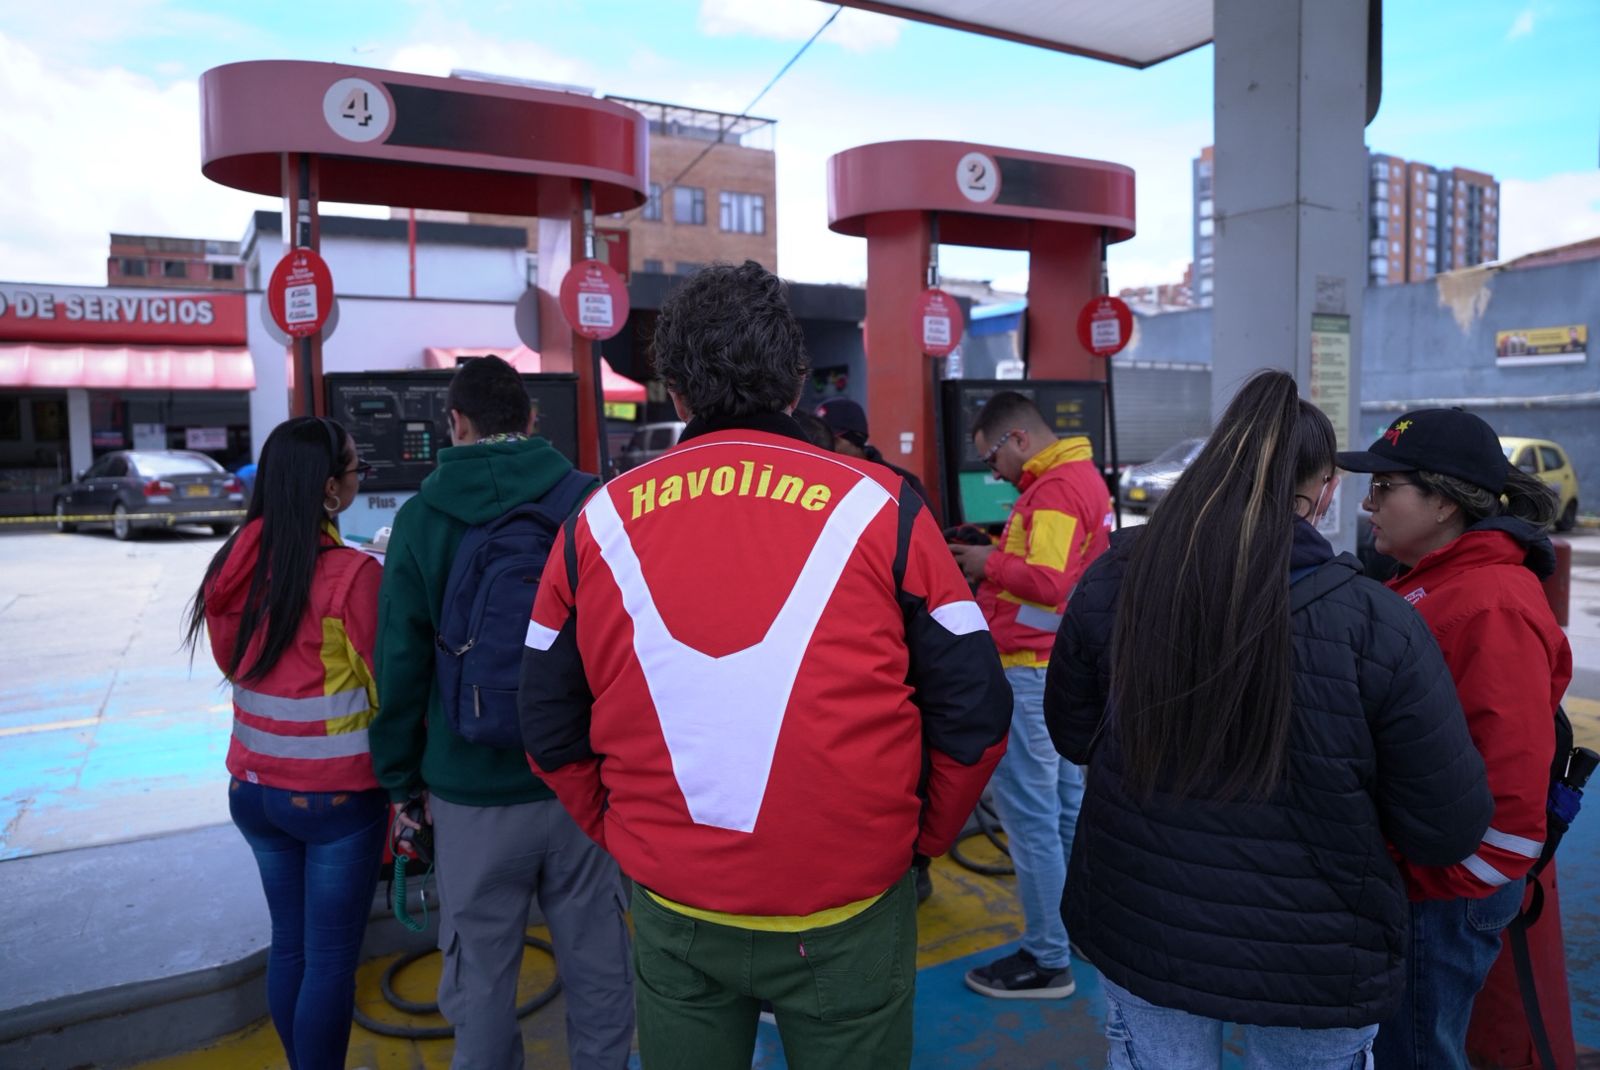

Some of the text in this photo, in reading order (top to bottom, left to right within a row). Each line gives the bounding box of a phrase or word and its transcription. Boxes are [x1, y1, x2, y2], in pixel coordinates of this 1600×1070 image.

[339, 86, 373, 127] 4
[966, 160, 987, 191] 2
[15, 292, 56, 320] DE
[65, 294, 215, 325] SERVICIOS
[367, 495, 398, 510] Plus
[628, 460, 832, 521] Havoline
